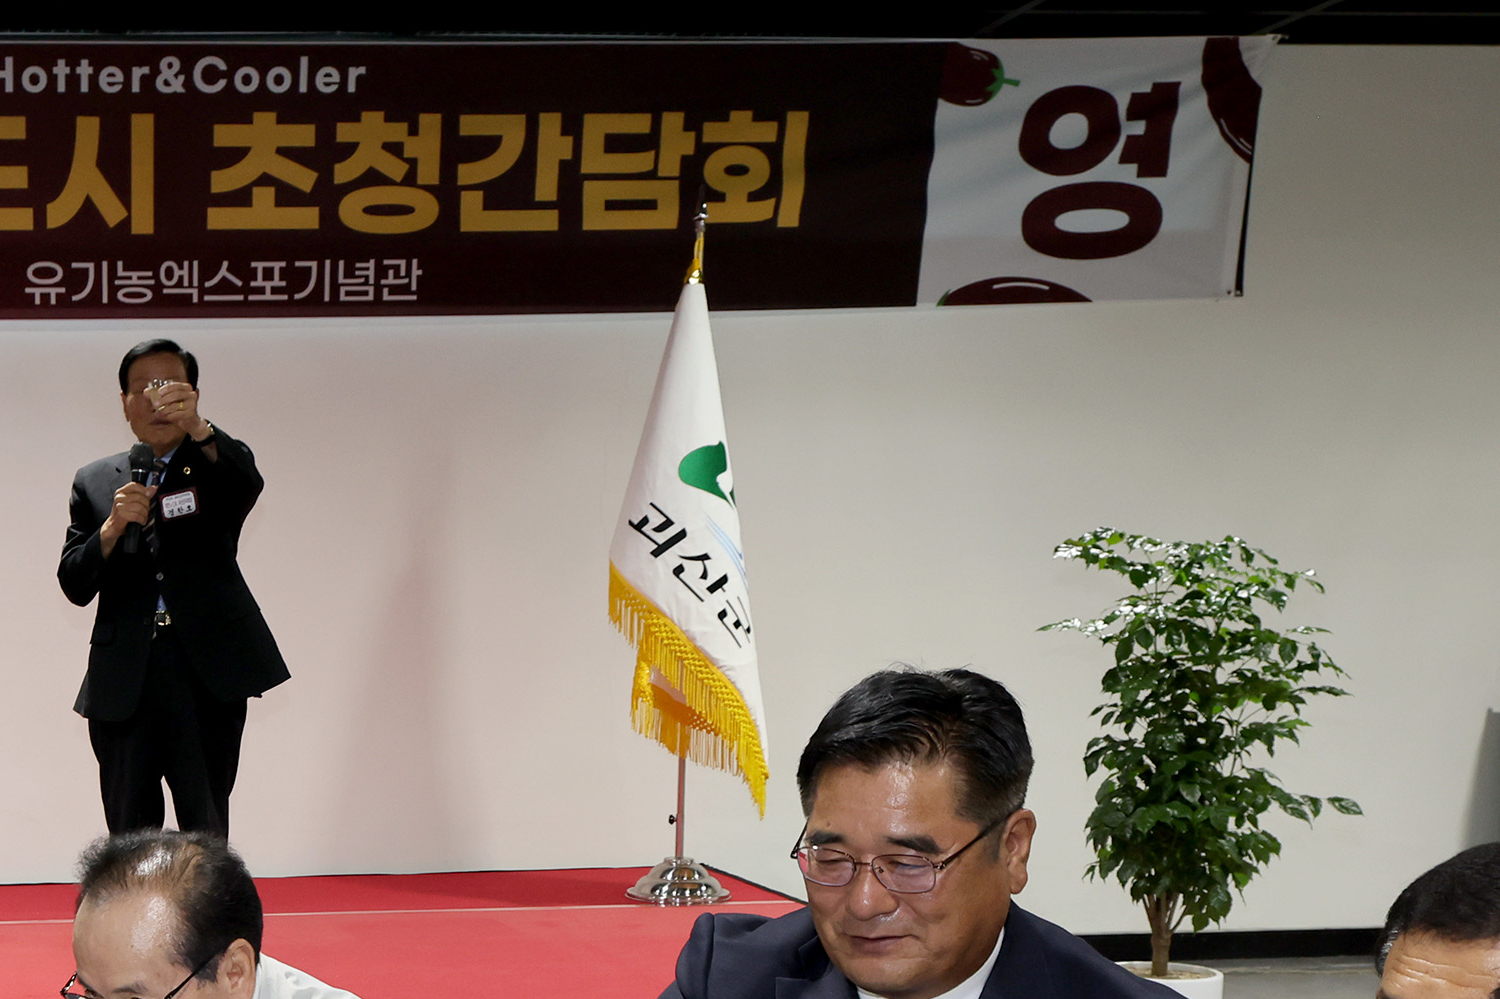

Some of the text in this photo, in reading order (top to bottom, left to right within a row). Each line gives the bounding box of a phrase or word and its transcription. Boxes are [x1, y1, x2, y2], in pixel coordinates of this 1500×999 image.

[206, 110, 809, 234] 초청간담회
[1018, 81, 1182, 260] 영
[24, 258, 423, 305] 유기농엑스포기념관
